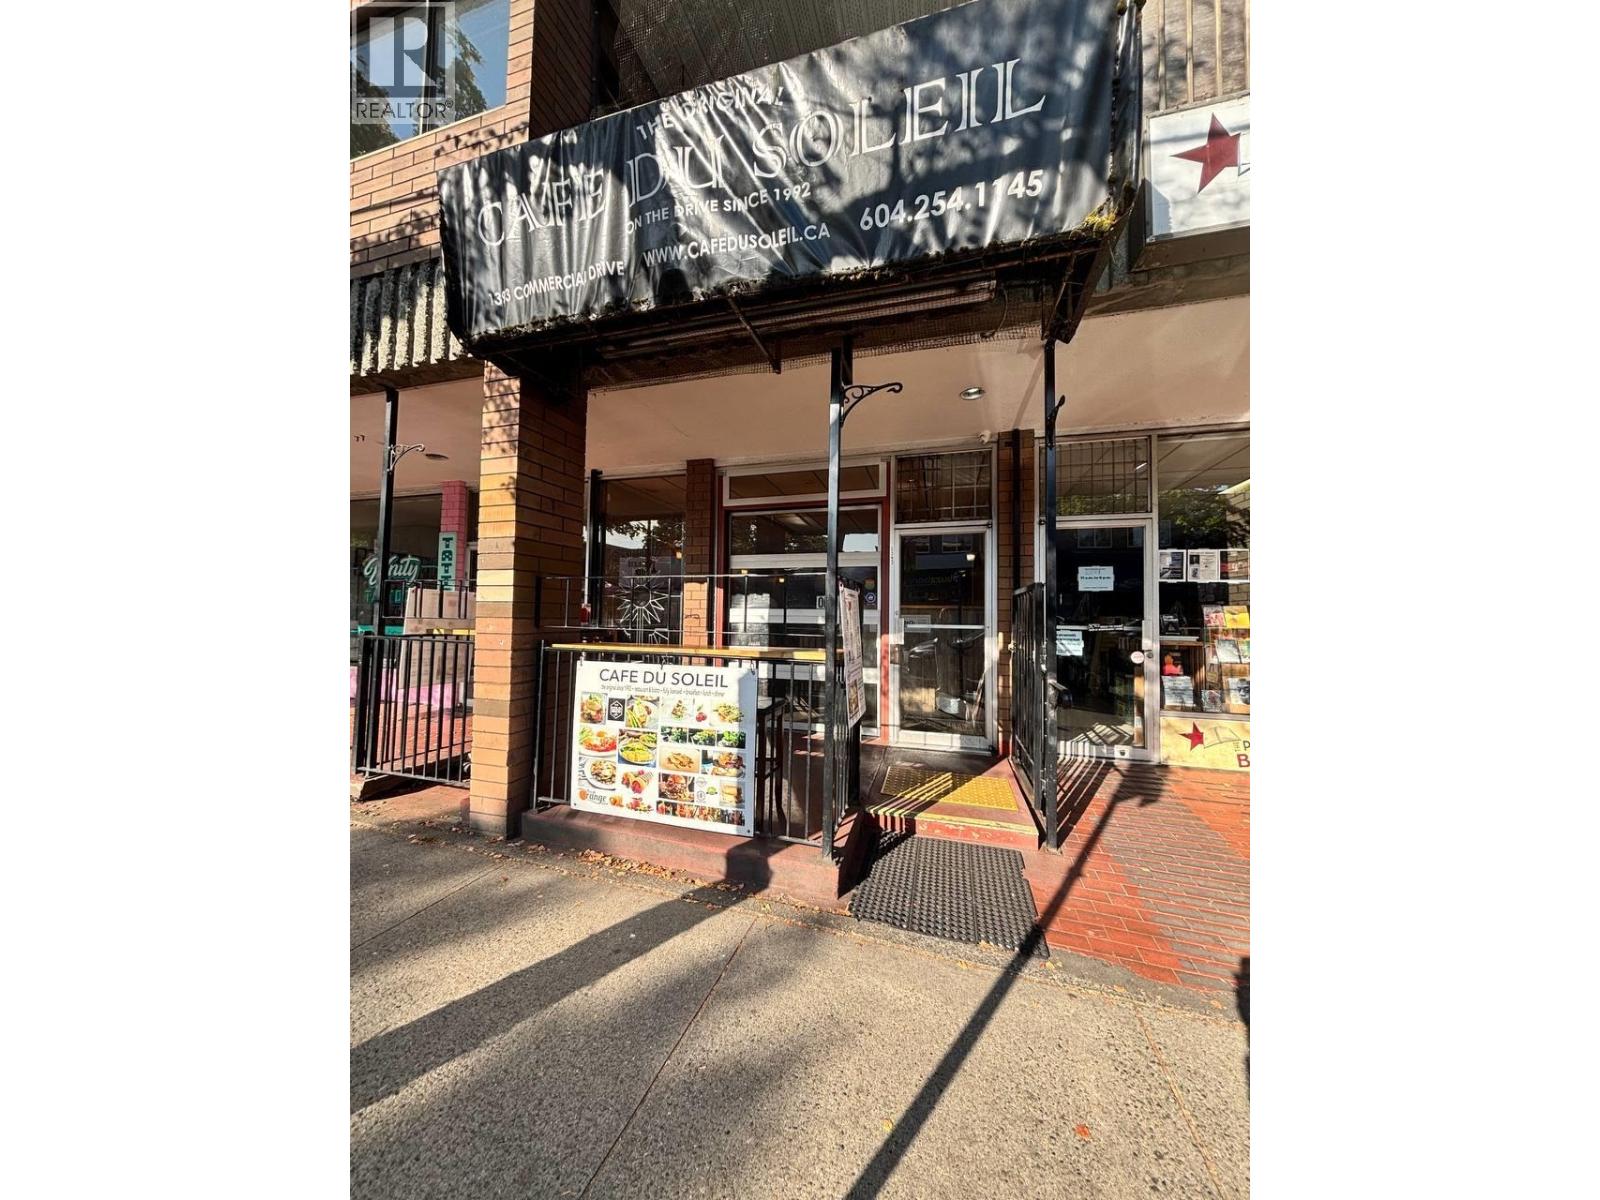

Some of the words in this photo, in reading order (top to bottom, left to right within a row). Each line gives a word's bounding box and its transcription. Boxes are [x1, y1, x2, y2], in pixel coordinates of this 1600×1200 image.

[626, 134, 725, 207] DU
[753, 58, 1046, 178] SOLEIL
[636, 112, 675, 140] THE
[627, 215, 643, 234] ON
[644, 207, 669, 224] THE
[674, 199, 720, 217] DRIVE
[723, 189, 768, 212] SINCE
[774, 182, 811, 200] 1992
[860, 169, 1044, 231] 604.254.1145
[643, 222, 831, 267] WWW.CAFEDUSOLEIL.CA
[588, 260, 625, 280] DRIVE
[599, 668, 638, 683] CAFE
[643, 670, 666, 685] DU
[671, 672, 729, 688] SOLEIL
